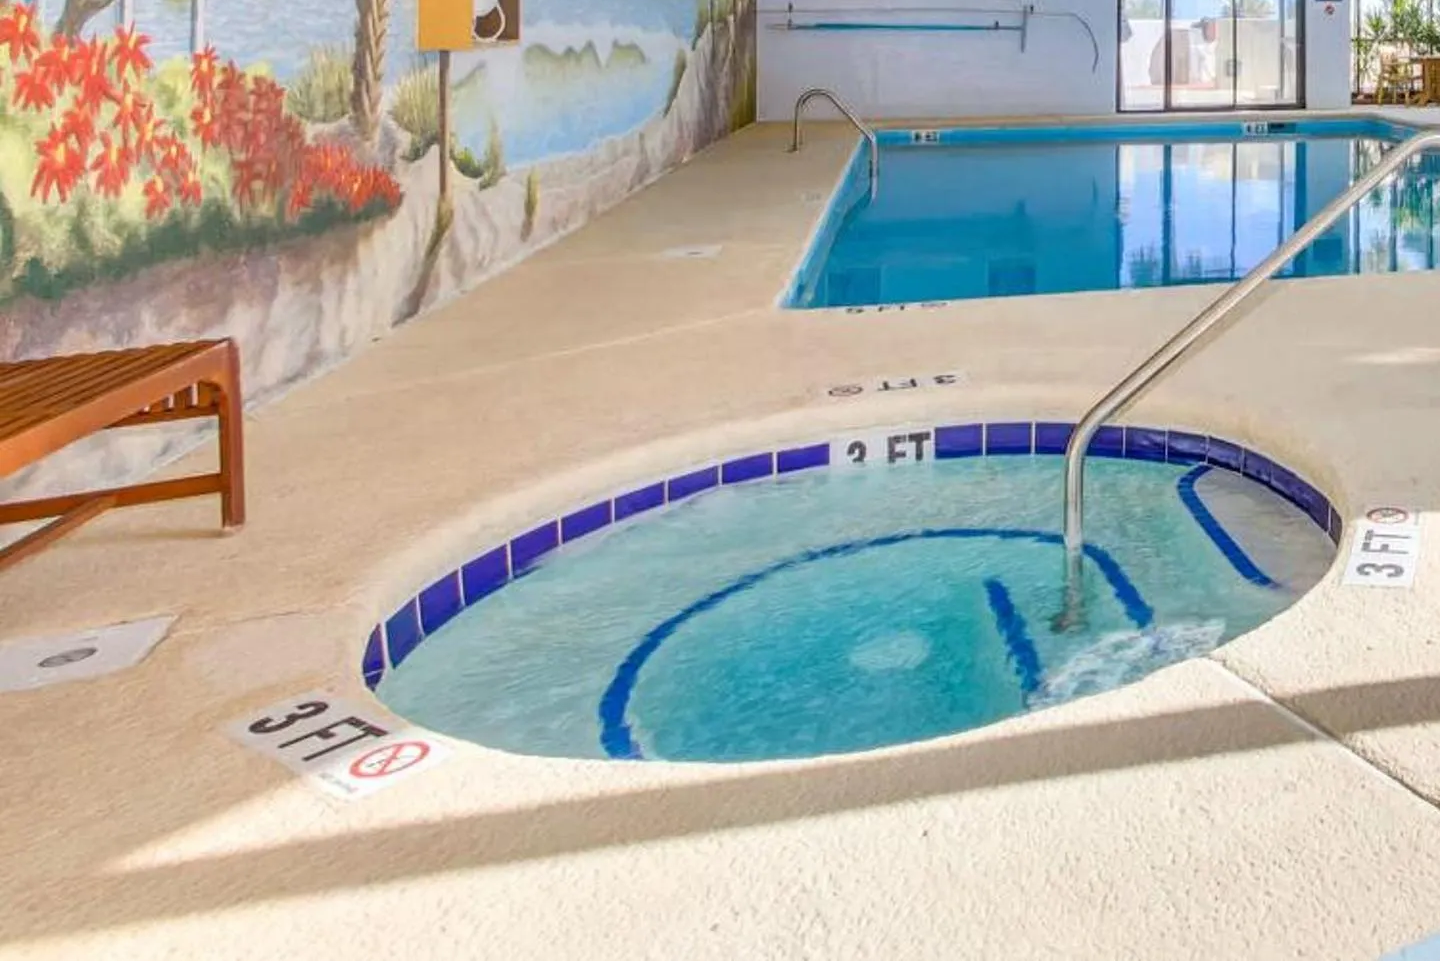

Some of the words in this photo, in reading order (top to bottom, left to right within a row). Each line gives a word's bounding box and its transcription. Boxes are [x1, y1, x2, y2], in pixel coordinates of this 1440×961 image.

[887, 431, 931, 463] FT
[1361, 529, 1413, 555] FT
[1356, 563, 1405, 579] 3
[248, 700, 330, 734] 3
[277, 716, 389, 762] FT
